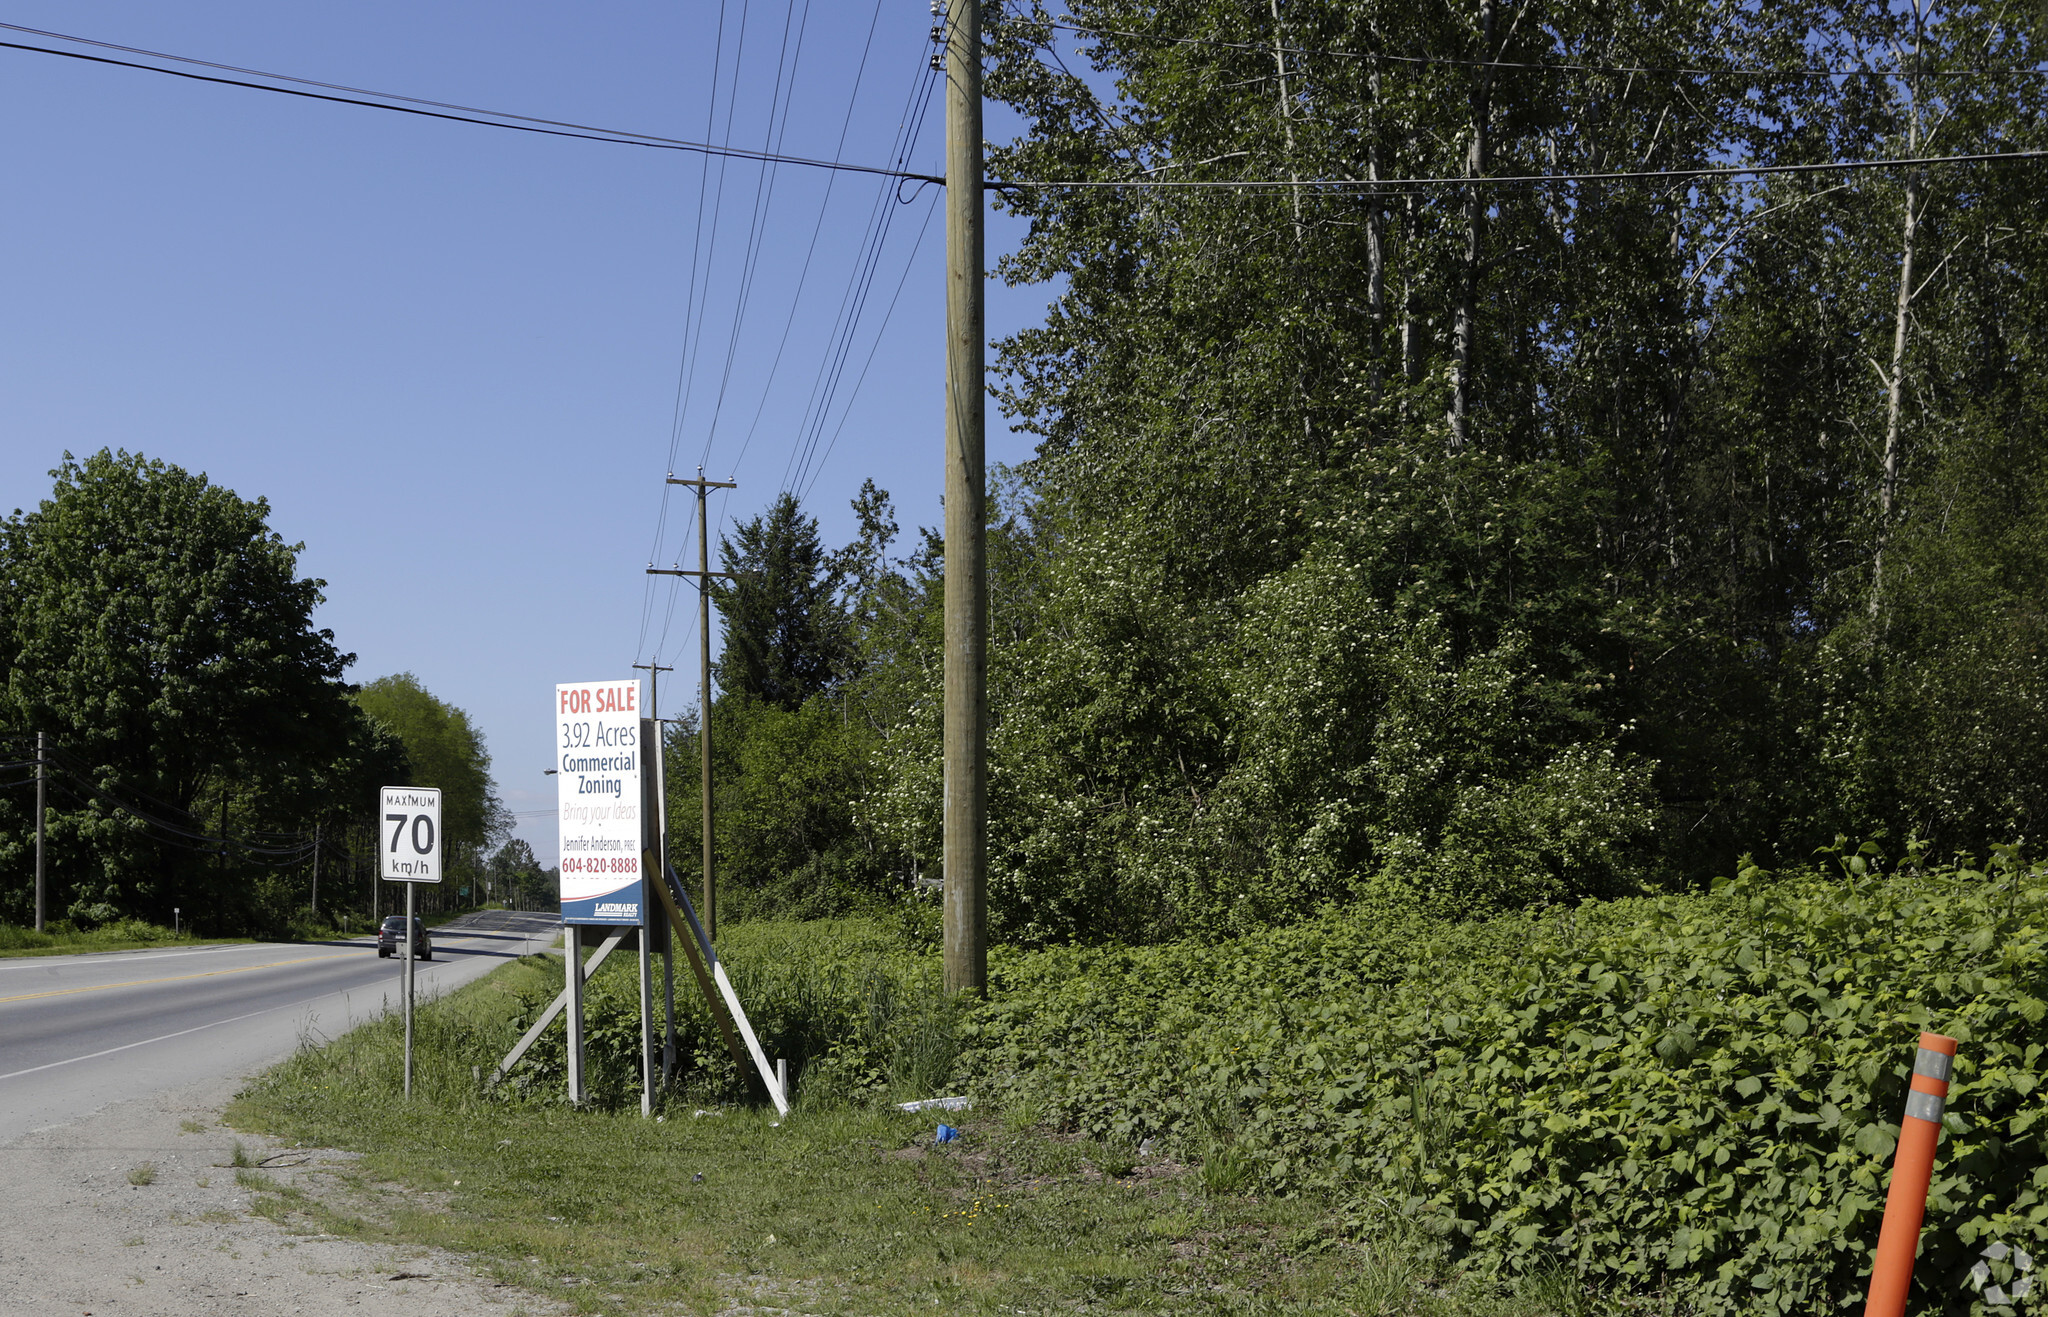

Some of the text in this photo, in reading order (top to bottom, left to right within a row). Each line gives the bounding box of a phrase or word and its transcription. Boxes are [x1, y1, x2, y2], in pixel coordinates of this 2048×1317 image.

[561, 687, 635, 714] FOR SALE
[562, 721, 636, 748] 3.92 Acres
[563, 751, 635, 772] Commercial
[578, 774, 621, 798] Zoning
[386, 795, 435, 807] MAXIMUM
[563, 801, 636, 825] Bring your Ideas
[386, 814, 434, 855] 70
[563, 835, 589, 852] Jennifer
[591, 835, 623, 853] Anderson,
[392, 859, 429, 874] km/h
[562, 857, 637, 873] 604-820-8888
[594, 903, 638, 912] LANDMARK
